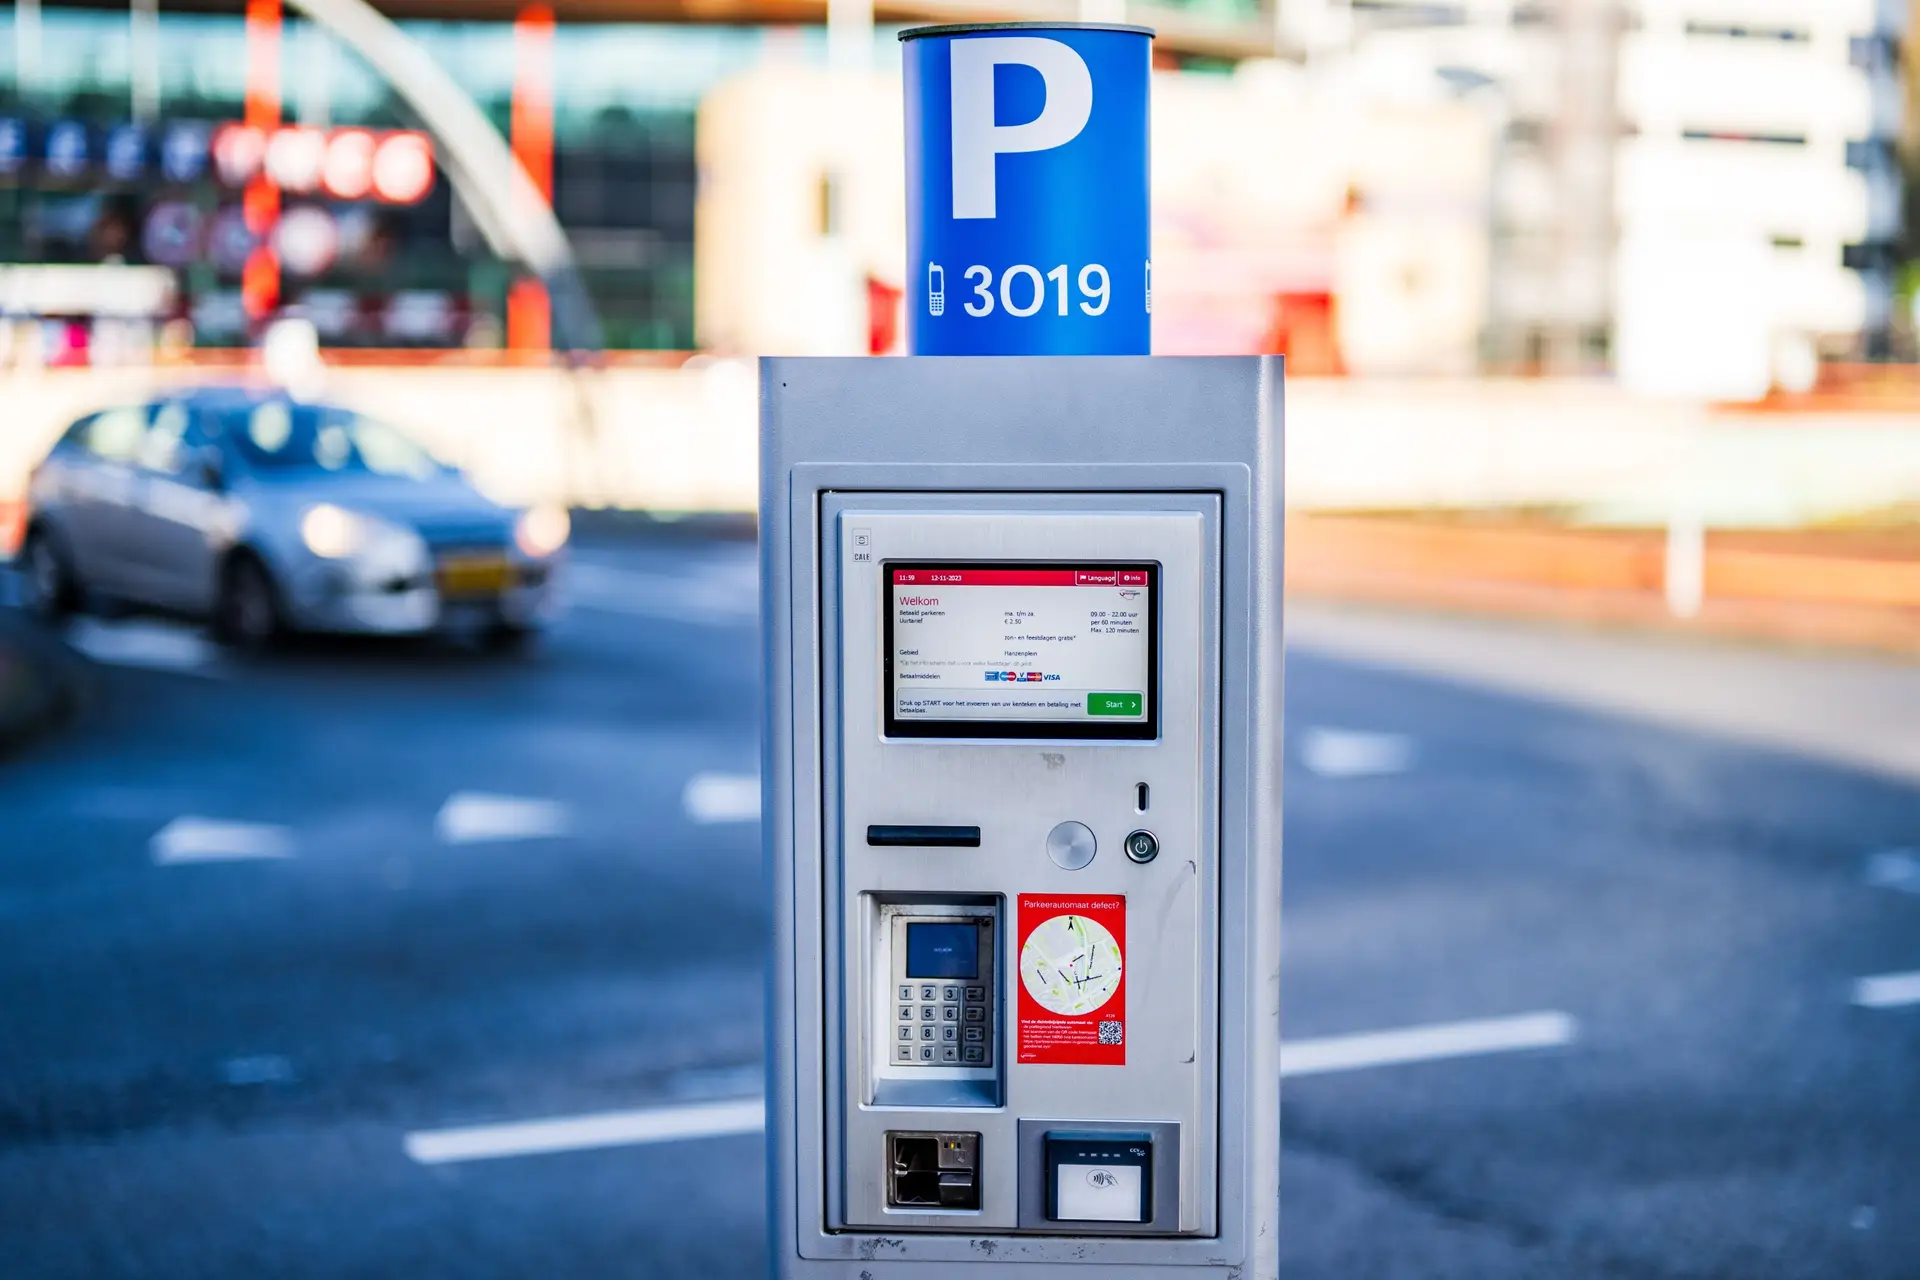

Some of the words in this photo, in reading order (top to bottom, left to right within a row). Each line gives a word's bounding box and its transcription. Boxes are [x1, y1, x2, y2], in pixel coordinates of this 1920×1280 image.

[950, 36, 1093, 219] P
[963, 263, 1111, 317] 3019
[1087, 574, 1115, 583] Language
[899, 596, 939, 606] Welkom
[1026, 634, 1057, 642] feestdagen
[899, 672, 941, 680] Betaalmiddelen
[1012, 700, 1037, 708] kenteken
[1046, 701, 1070, 709] betaling
[1105, 700, 1124, 709] Start
[1023, 900, 1090, 909] Parkeerautomaat
[1090, 901, 1120, 910] defect?
[903, 989, 909, 998] 1
[924, 989, 932, 998] 2
[946, 989, 954, 999] 3
[902, 1008, 909, 1017] 4
[924, 1009, 932, 1018] 5
[946, 1009, 954, 1018] 6
[903, 1029, 909, 1037] 7
[923, 1029, 931, 1038] 8
[946, 1030, 953, 1039] 9
[923, 1049, 931, 1058] 0
